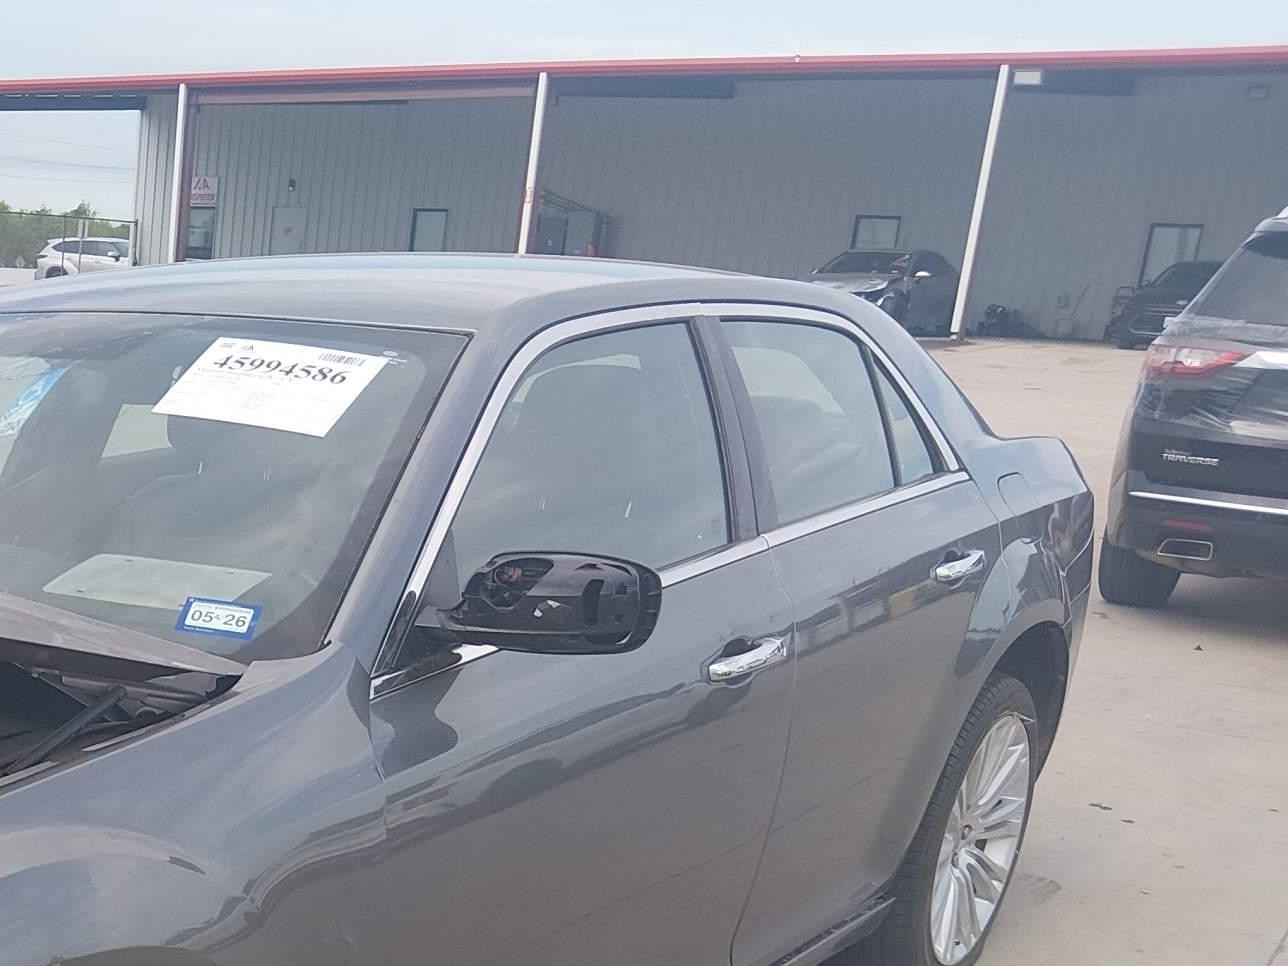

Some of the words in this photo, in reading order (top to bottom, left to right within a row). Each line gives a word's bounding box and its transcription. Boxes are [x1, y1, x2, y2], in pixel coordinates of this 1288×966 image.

[213, 354, 353, 385] 45994586
[1161, 453, 1220, 466] TRAVERSE
[190, 609, 215, 624] 05
[222, 613, 248, 628] 26
